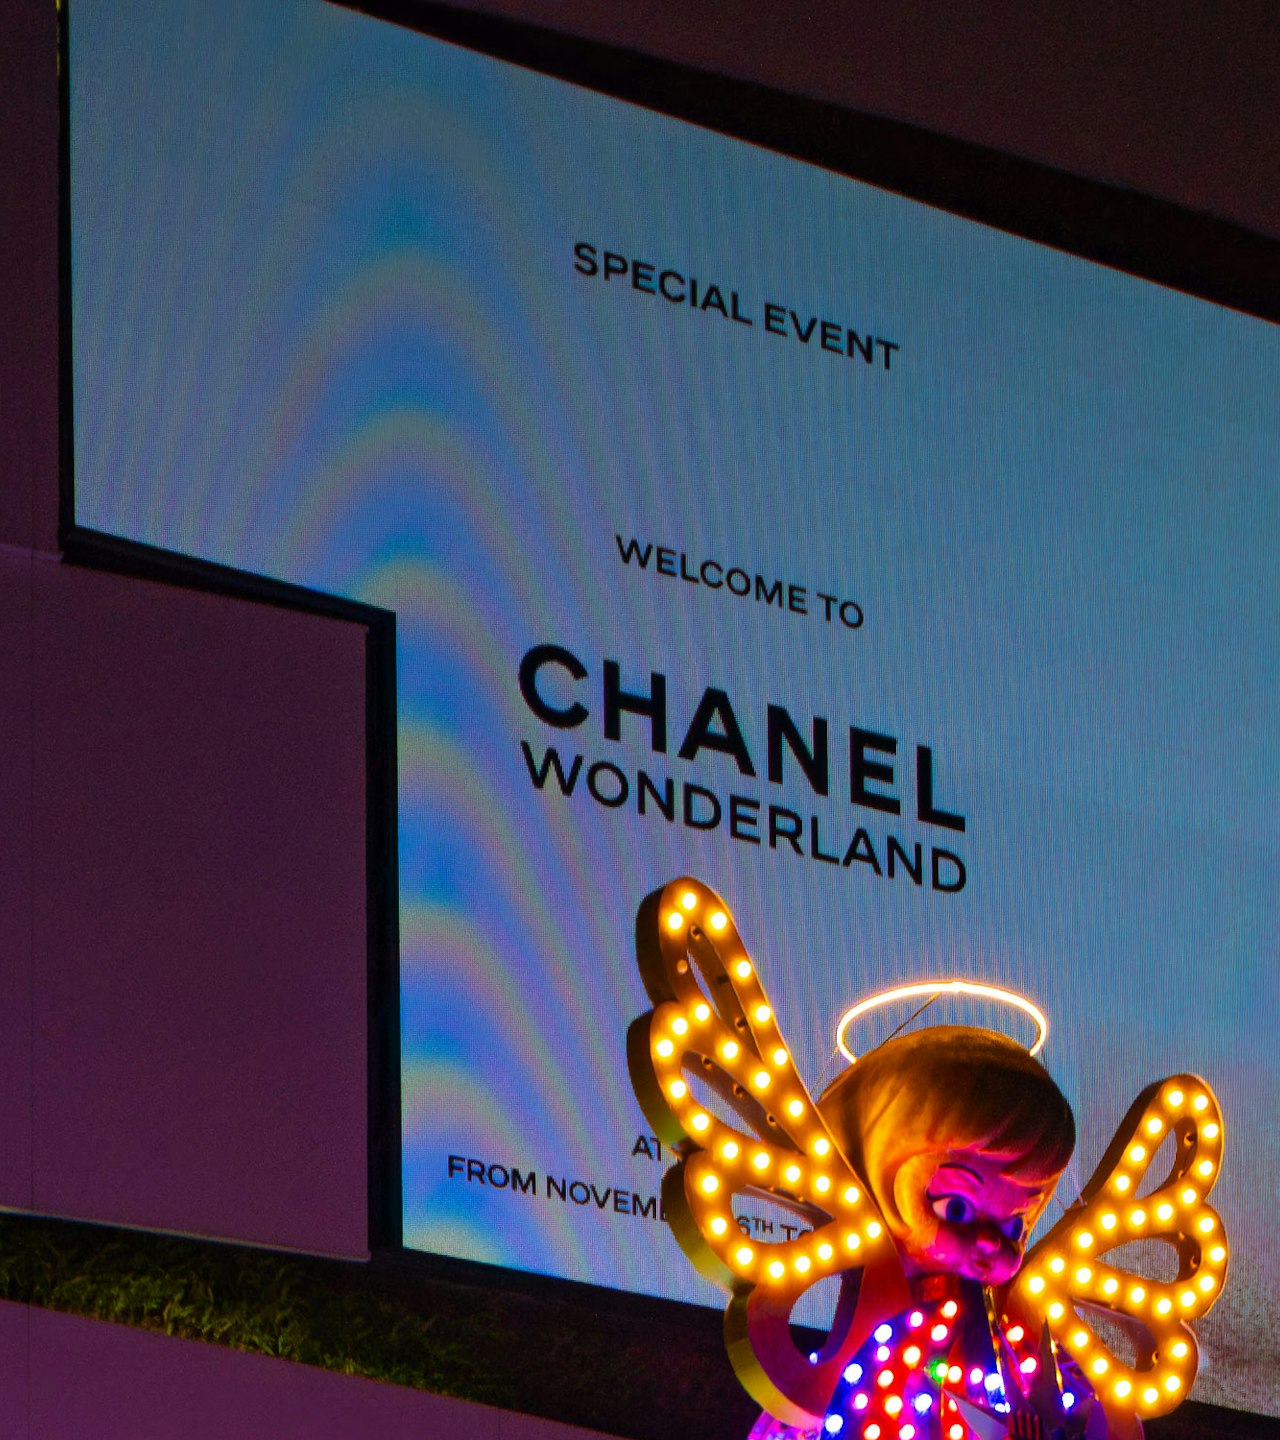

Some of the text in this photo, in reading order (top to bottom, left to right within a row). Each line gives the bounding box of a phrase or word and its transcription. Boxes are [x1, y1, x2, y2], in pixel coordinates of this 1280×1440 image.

[574, 242, 900, 370] SPECIAL EVENT
[615, 534, 865, 630] WELCOME TO
[518, 643, 967, 832] CHANEL
[521, 740, 968, 894] WONDERLAND
[447, 1154, 537, 1195] FROM
